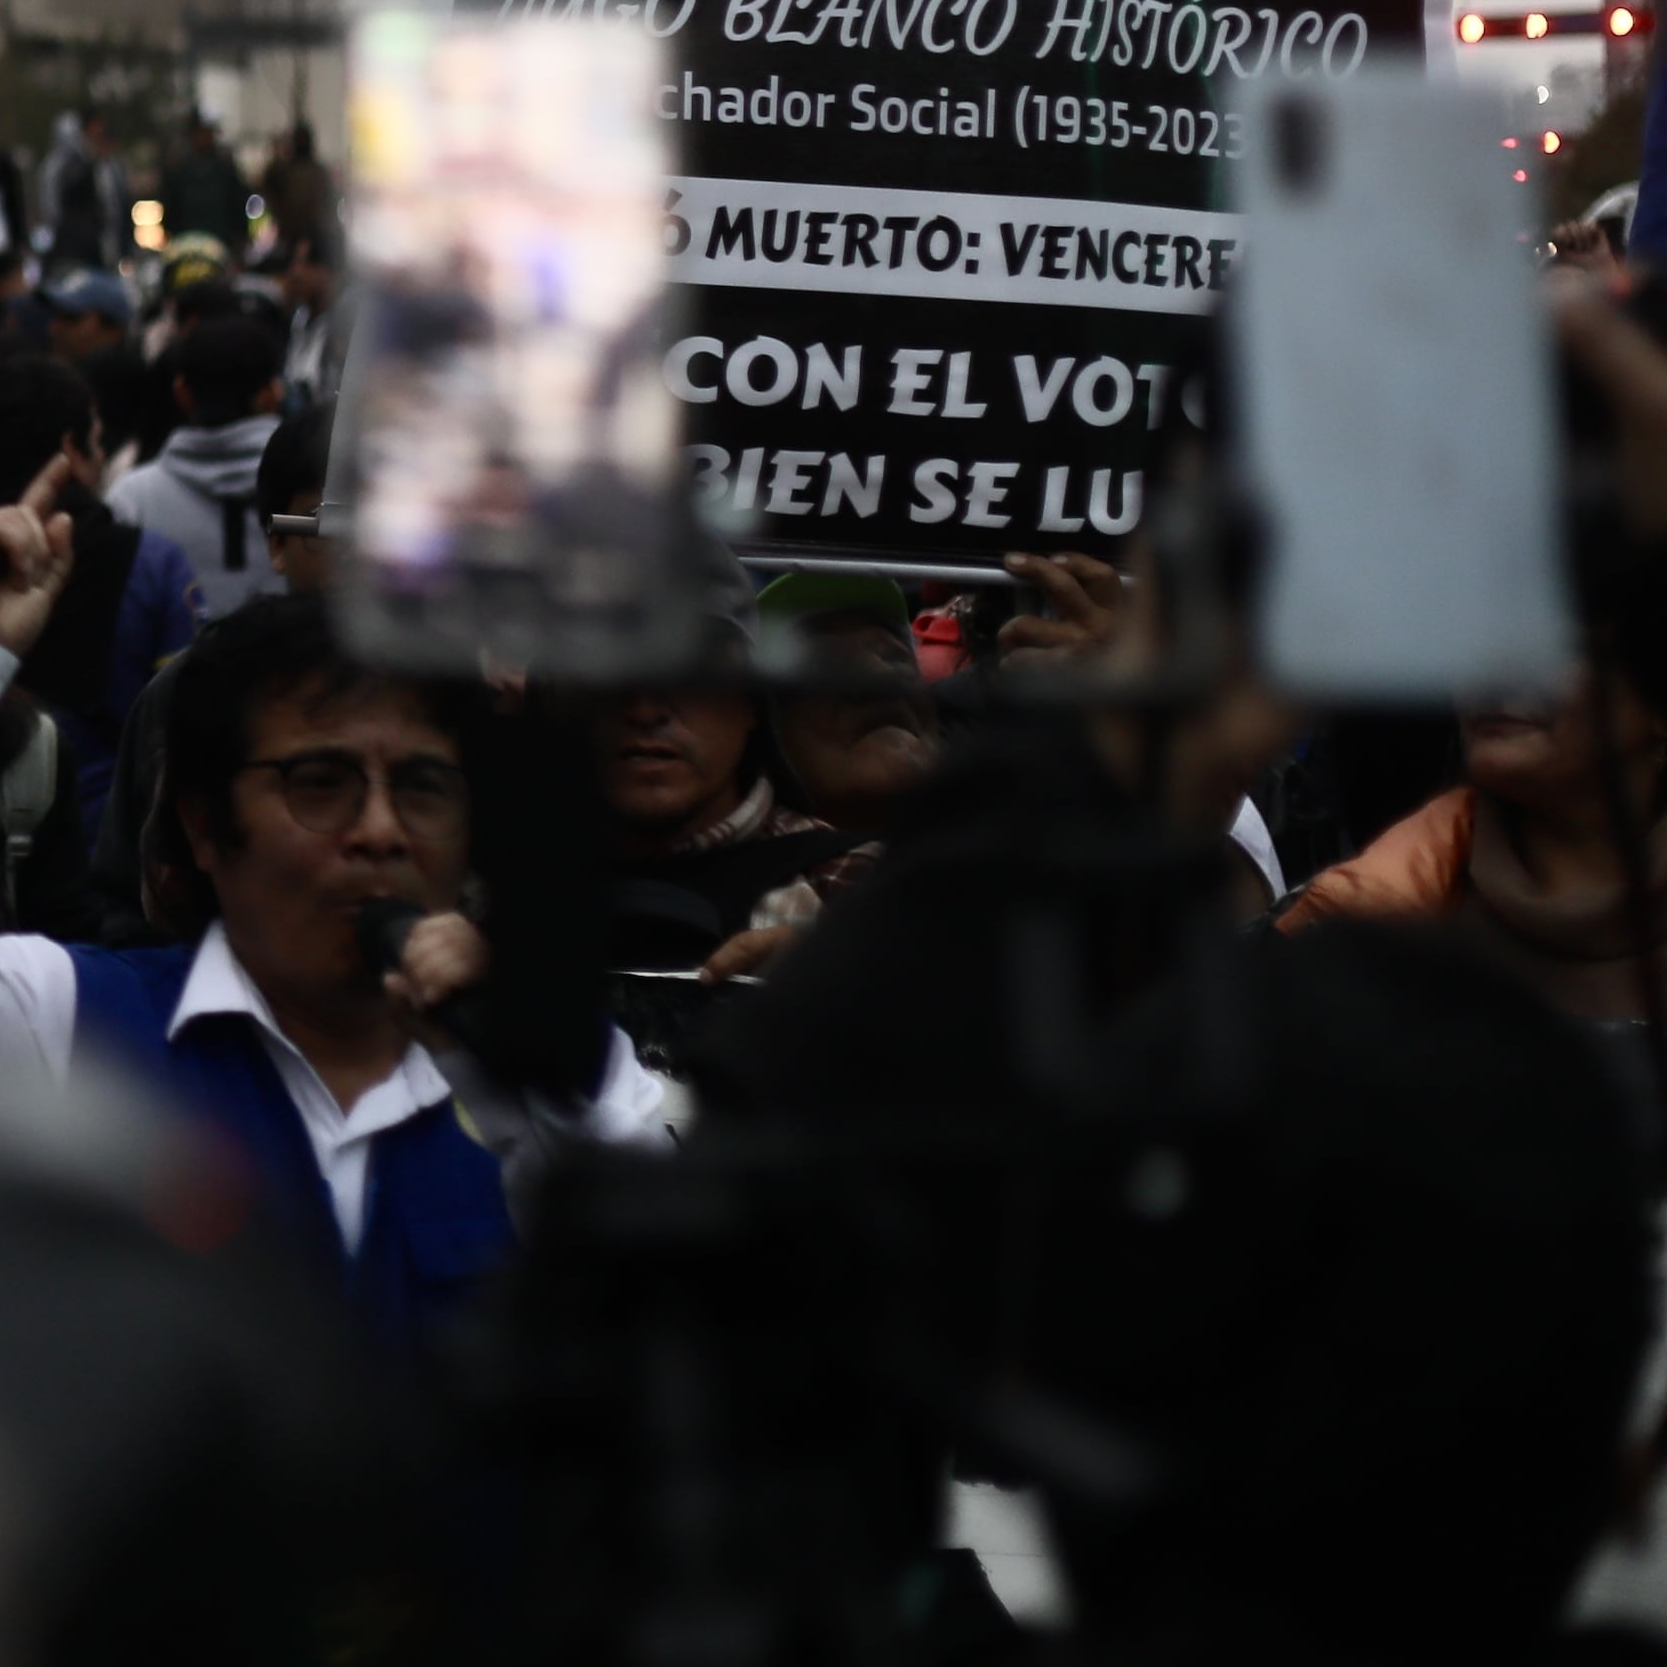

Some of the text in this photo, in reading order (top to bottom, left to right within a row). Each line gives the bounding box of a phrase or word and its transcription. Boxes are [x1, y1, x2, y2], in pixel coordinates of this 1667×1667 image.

[654, 73, 1245, 162] chador Social (1935-2023
[705, 204, 981, 276] MUERTO:
[1001, 221, 1234, 293] VENCERE
[667, 335, 863, 414] CON
[887, 348, 987, 420] EL
[692, 442, 886, 520] BIEN
[910, 455, 1018, 530] SE
